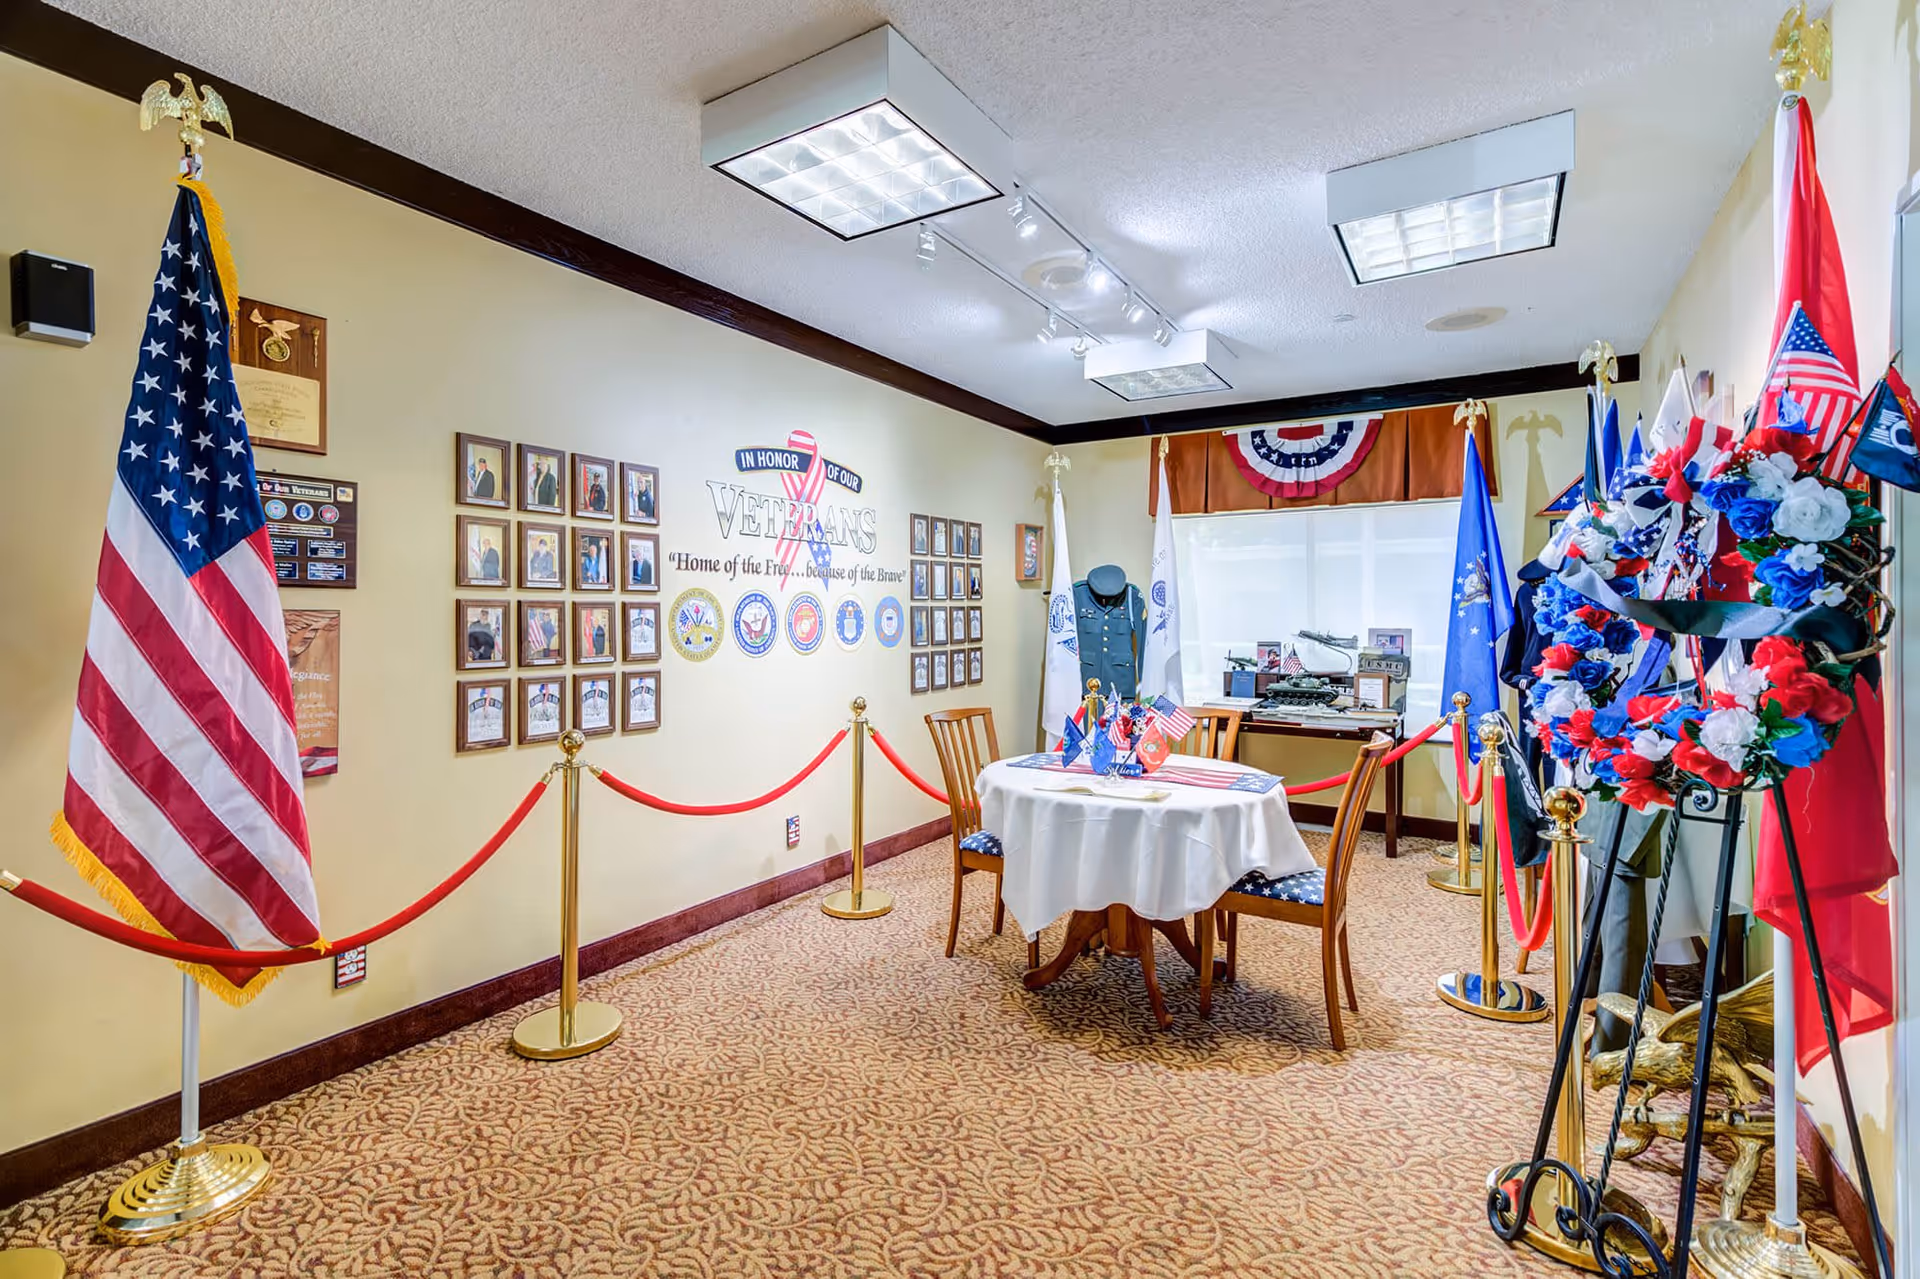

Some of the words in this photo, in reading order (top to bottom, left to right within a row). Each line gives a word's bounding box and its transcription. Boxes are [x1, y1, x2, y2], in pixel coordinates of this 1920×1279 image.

[740, 452, 754, 468] IN
[757, 451, 799, 470] HONOR
[827, 464, 840, 480] OF
[840, 470, 859, 491] OUR
[706, 480, 877, 554] VETERANS
[669, 551, 720, 573] "Home
[724, 554, 740, 581] of
[742, 555, 762, 575] the
[848, 563, 859, 587] of
[860, 564, 876, 581] the
[877, 567, 907, 583] Brave"
[290, 667, 331, 682] legiance
